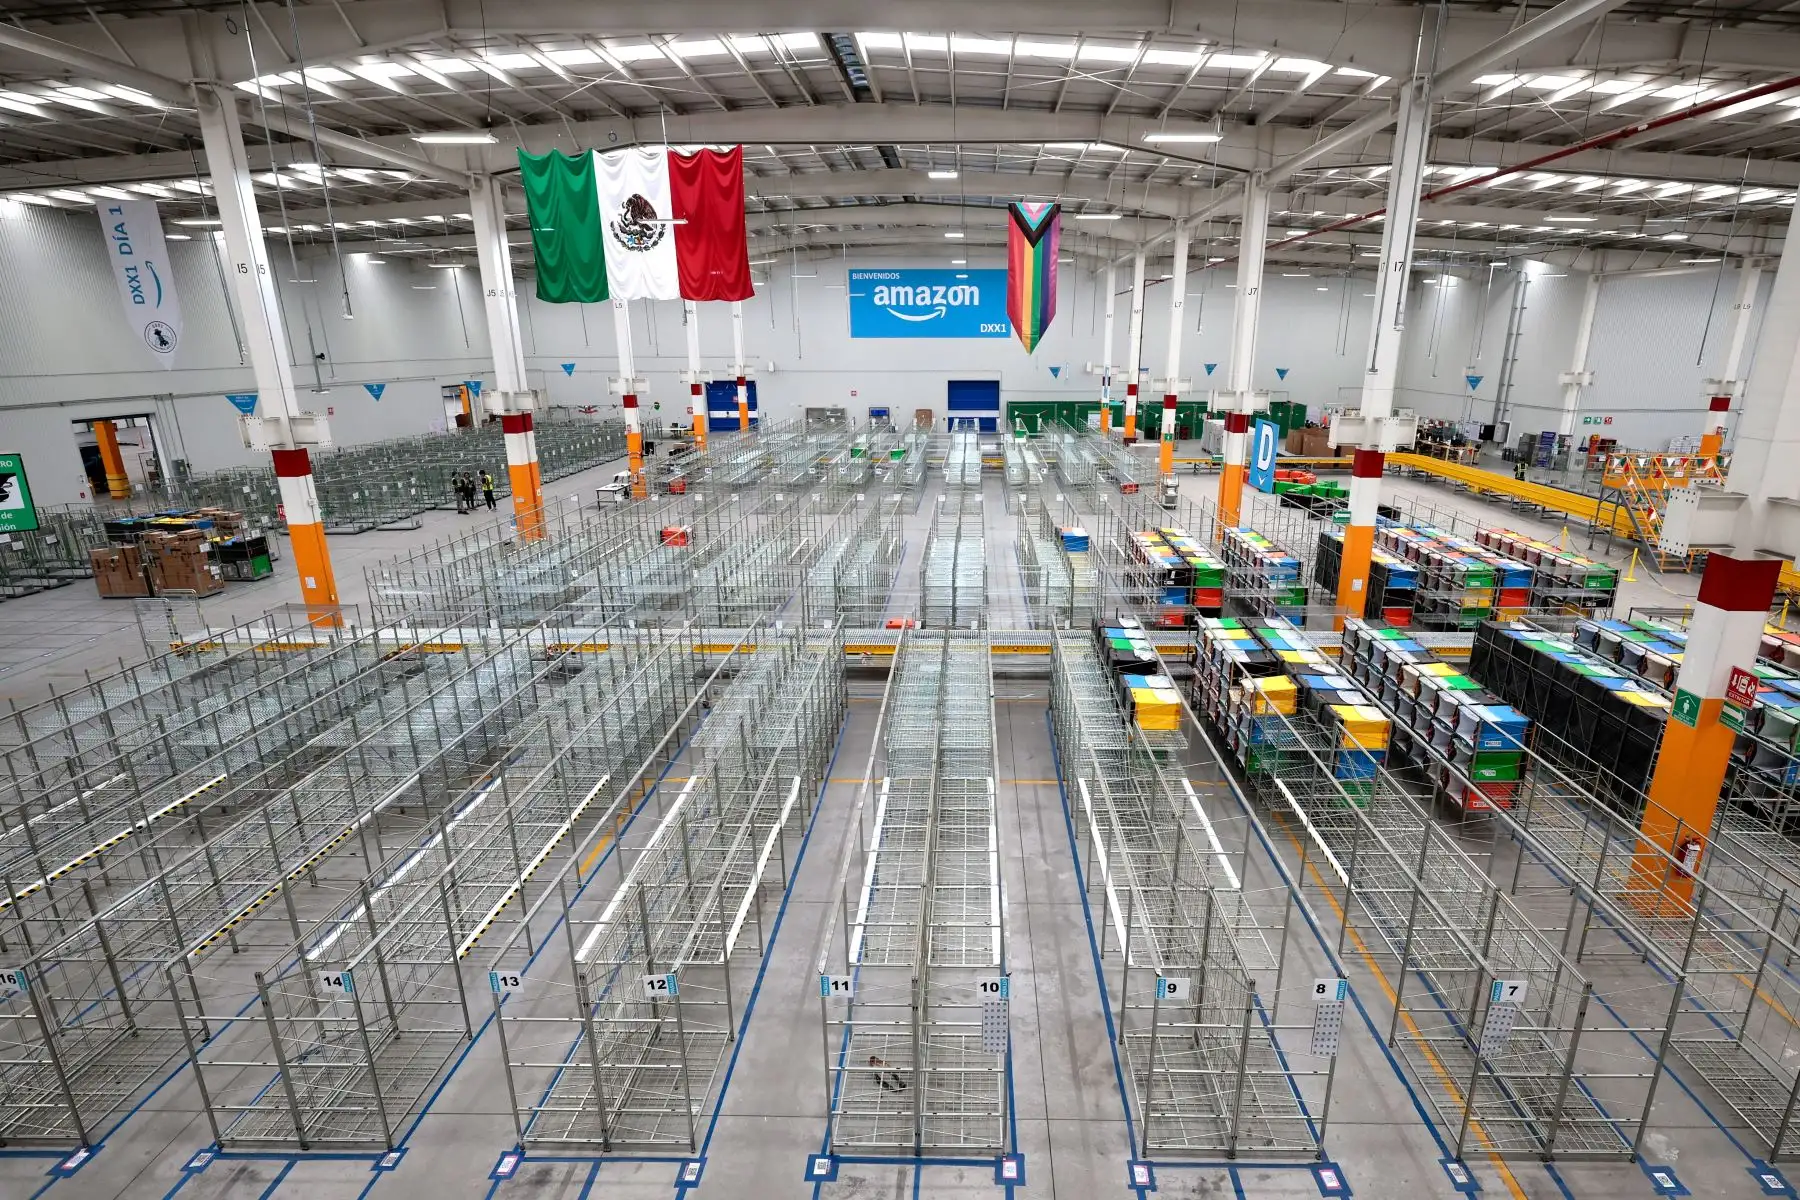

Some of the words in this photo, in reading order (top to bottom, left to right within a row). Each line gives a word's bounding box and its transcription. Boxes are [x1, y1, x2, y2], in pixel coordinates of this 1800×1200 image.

[109, 205, 123, 216] 1
[112, 222, 133, 255] DÍA
[852, 272, 900, 280] BIENVENIDOS
[125, 265, 145, 305] DXX1
[873, 285, 980, 306] amazon
[980, 323, 1007, 333] DXX1
[1257, 423, 1274, 471] D
[0, 460, 13, 468] RO
[1, 511, 13, 519] de
[0, 522, 16, 531] ión
[0, 974, 16, 984] 16
[324, 976, 342, 986] 14
[500, 976, 520, 987] 13
[647, 979, 667, 990] 12
[831, 980, 849, 991] 11
[980, 982, 999, 992] 10
[1167, 983, 1177, 993] 9
[1315, 983, 1326, 994] 8
[1508, 985, 1519, 996] 7
